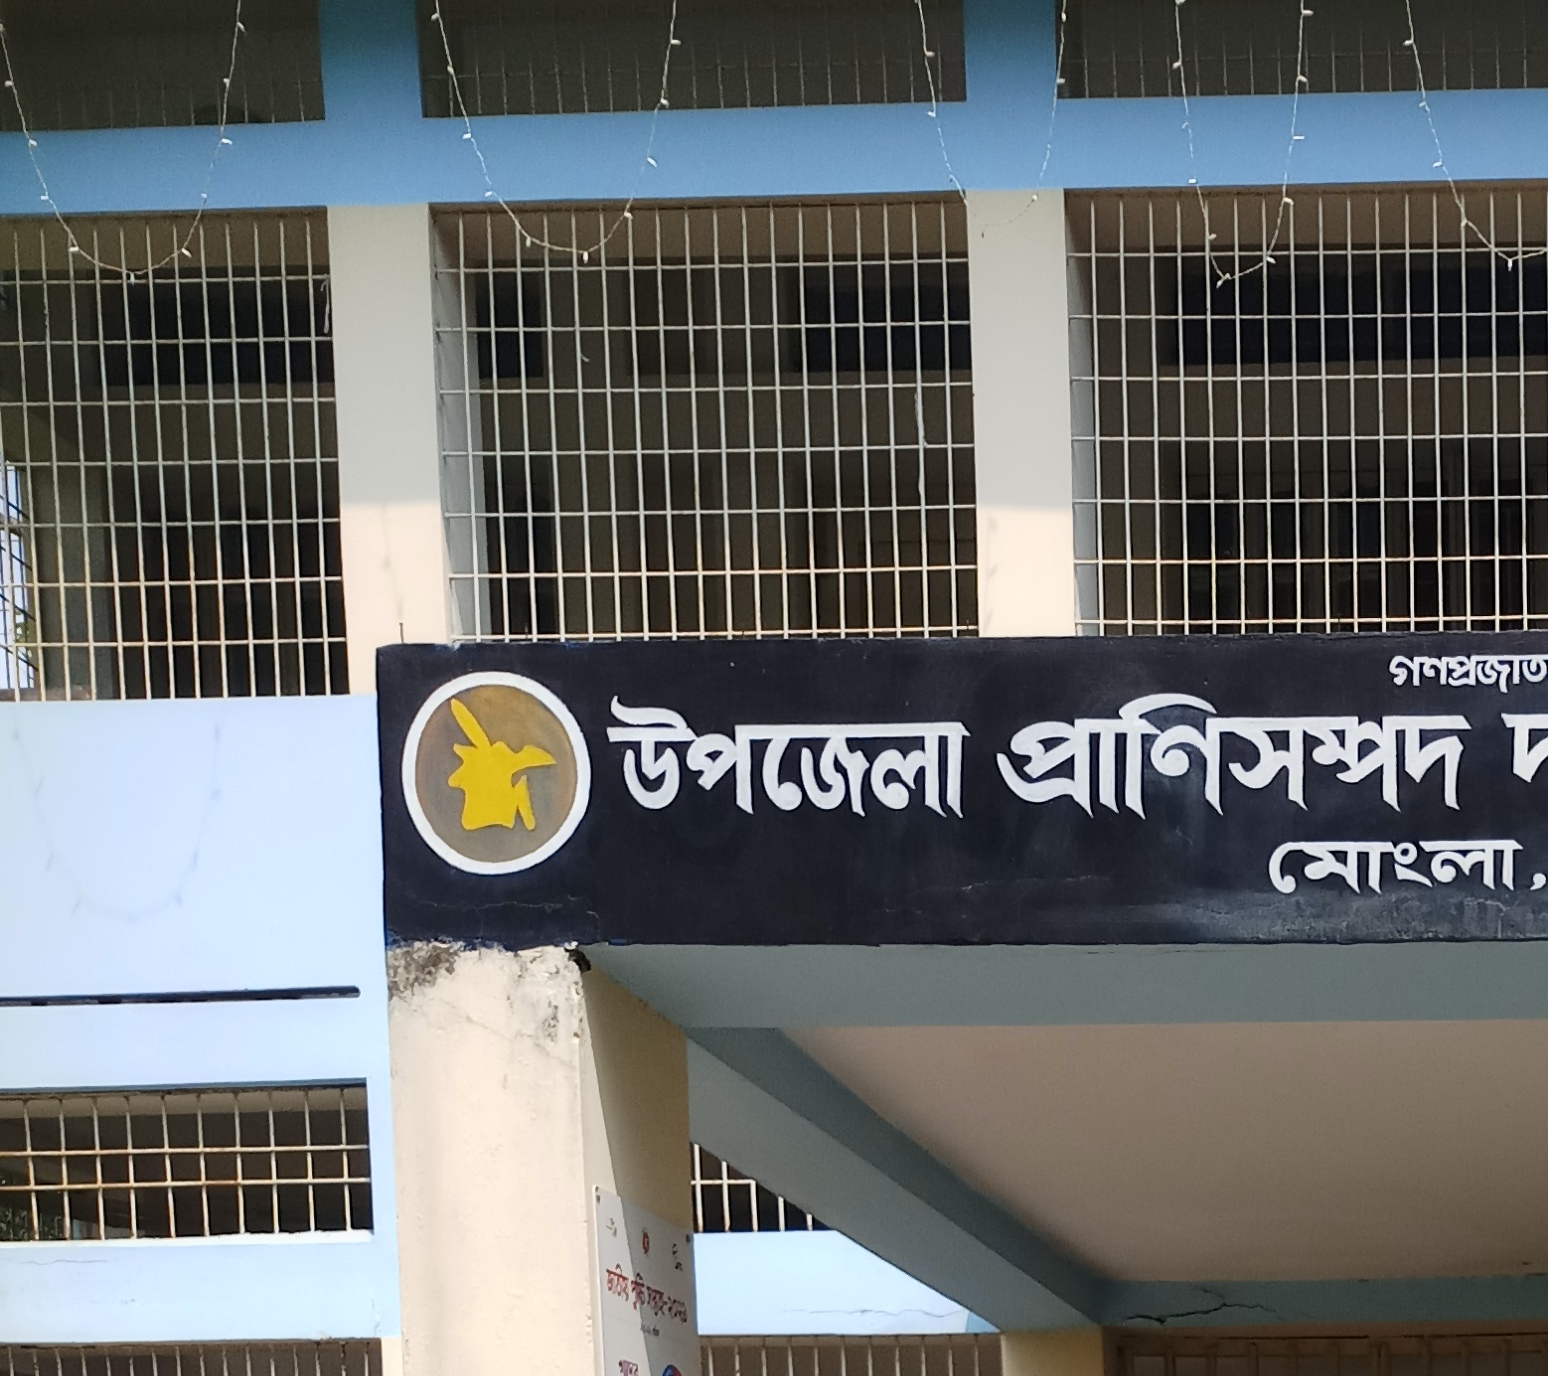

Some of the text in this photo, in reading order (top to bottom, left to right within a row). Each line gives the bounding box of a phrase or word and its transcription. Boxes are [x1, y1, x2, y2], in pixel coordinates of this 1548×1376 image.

[606, 695, 972, 819] উপজেলা
[996, 692, 1472, 820] প্রাণিসম্পদ
[1268, 839, 1548, 894] মোংলা,
